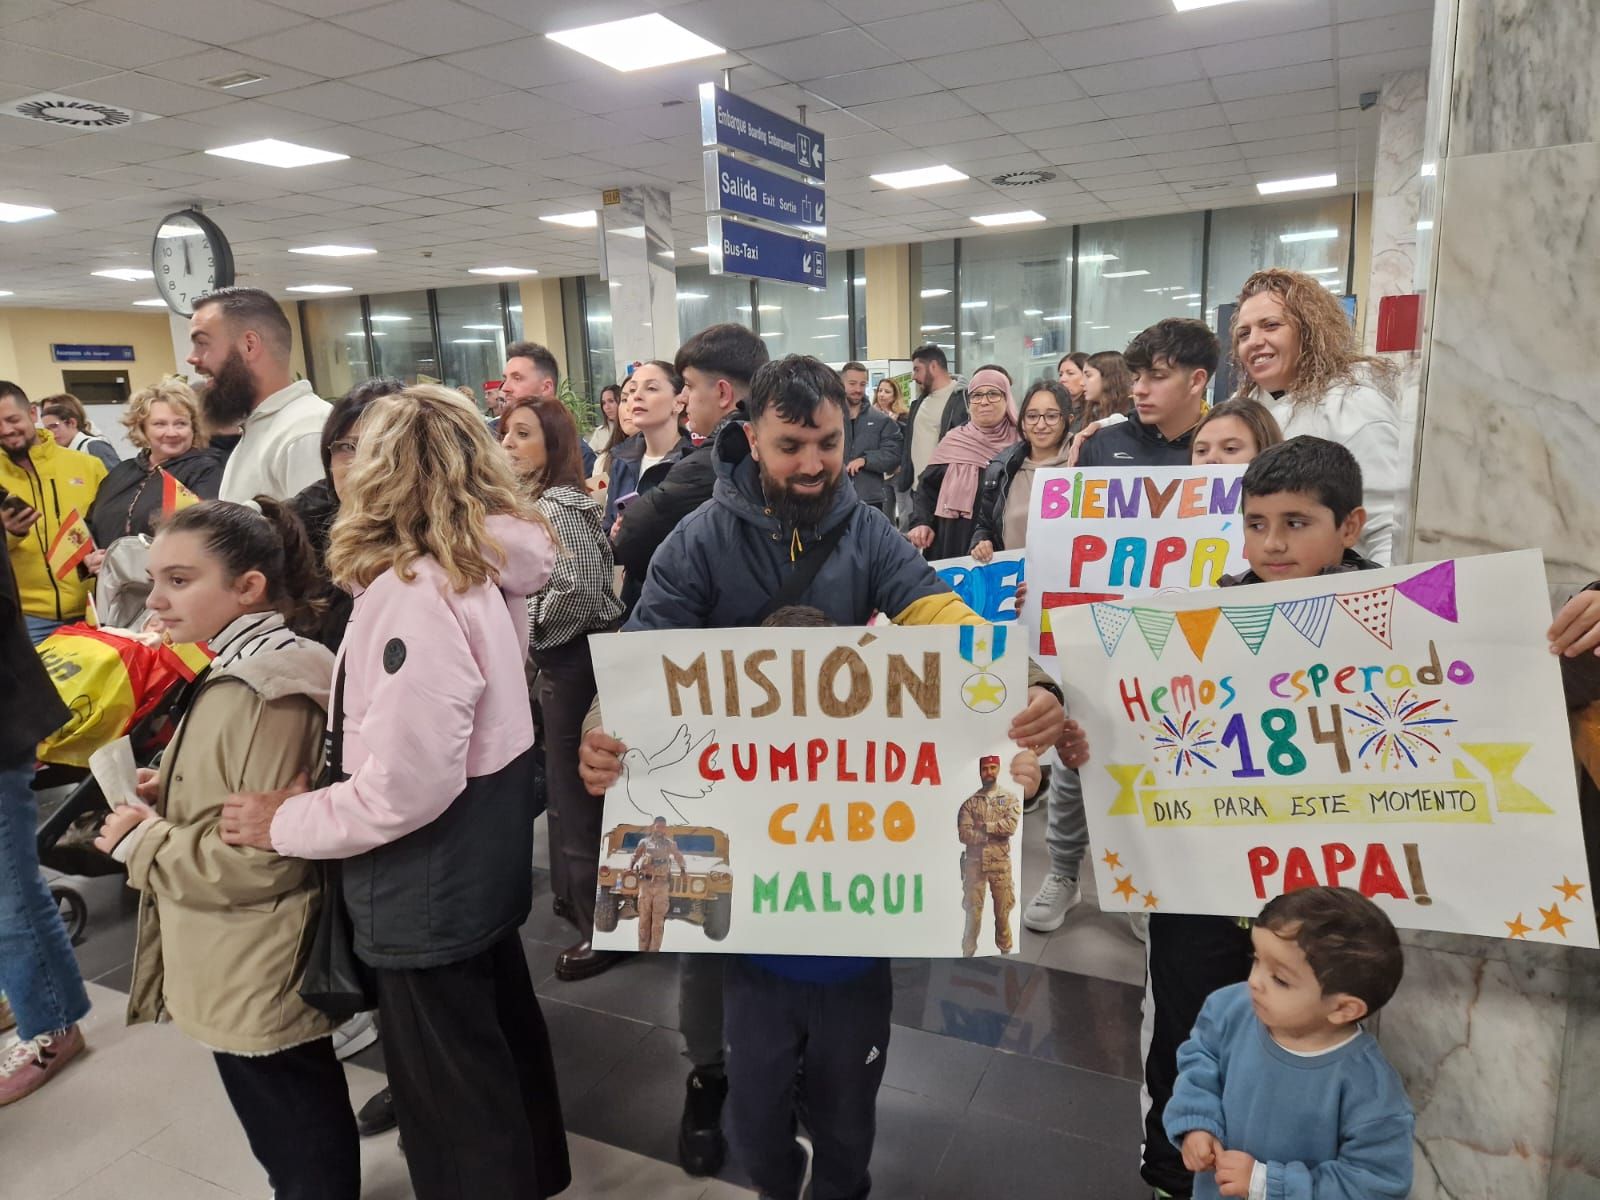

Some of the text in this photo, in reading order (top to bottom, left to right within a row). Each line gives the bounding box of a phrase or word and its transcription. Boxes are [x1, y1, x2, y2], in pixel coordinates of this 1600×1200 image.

[717, 105, 747, 135] Embarque
[748, 122, 767, 146] Boarding
[721, 171, 797, 214] Salida Exit Sortie
[163, 247, 172, 257] 10
[163, 264, 170, 274] 9
[207, 257, 215, 267] 3
[724, 239, 759, 261] Bus-Taxi
[169, 281, 176, 290] 8
[179, 292, 186, 303] 7
[208, 275, 215, 284] 4
[1069, 521, 1231, 589] PAPÁ
[662, 632, 942, 719] MISIÓN
[1119, 639, 1475, 722] Hemos esperado
[698, 738, 942, 786] CUMPLIDA
[1221, 704, 1351, 778] 184
[768, 800, 916, 845] CABO
[1153, 788, 1477, 823] DIAS PARA ESTE MOMENTO
[752, 871, 924, 916] MALQUI
[1247, 842, 1433, 906] PAPA!
